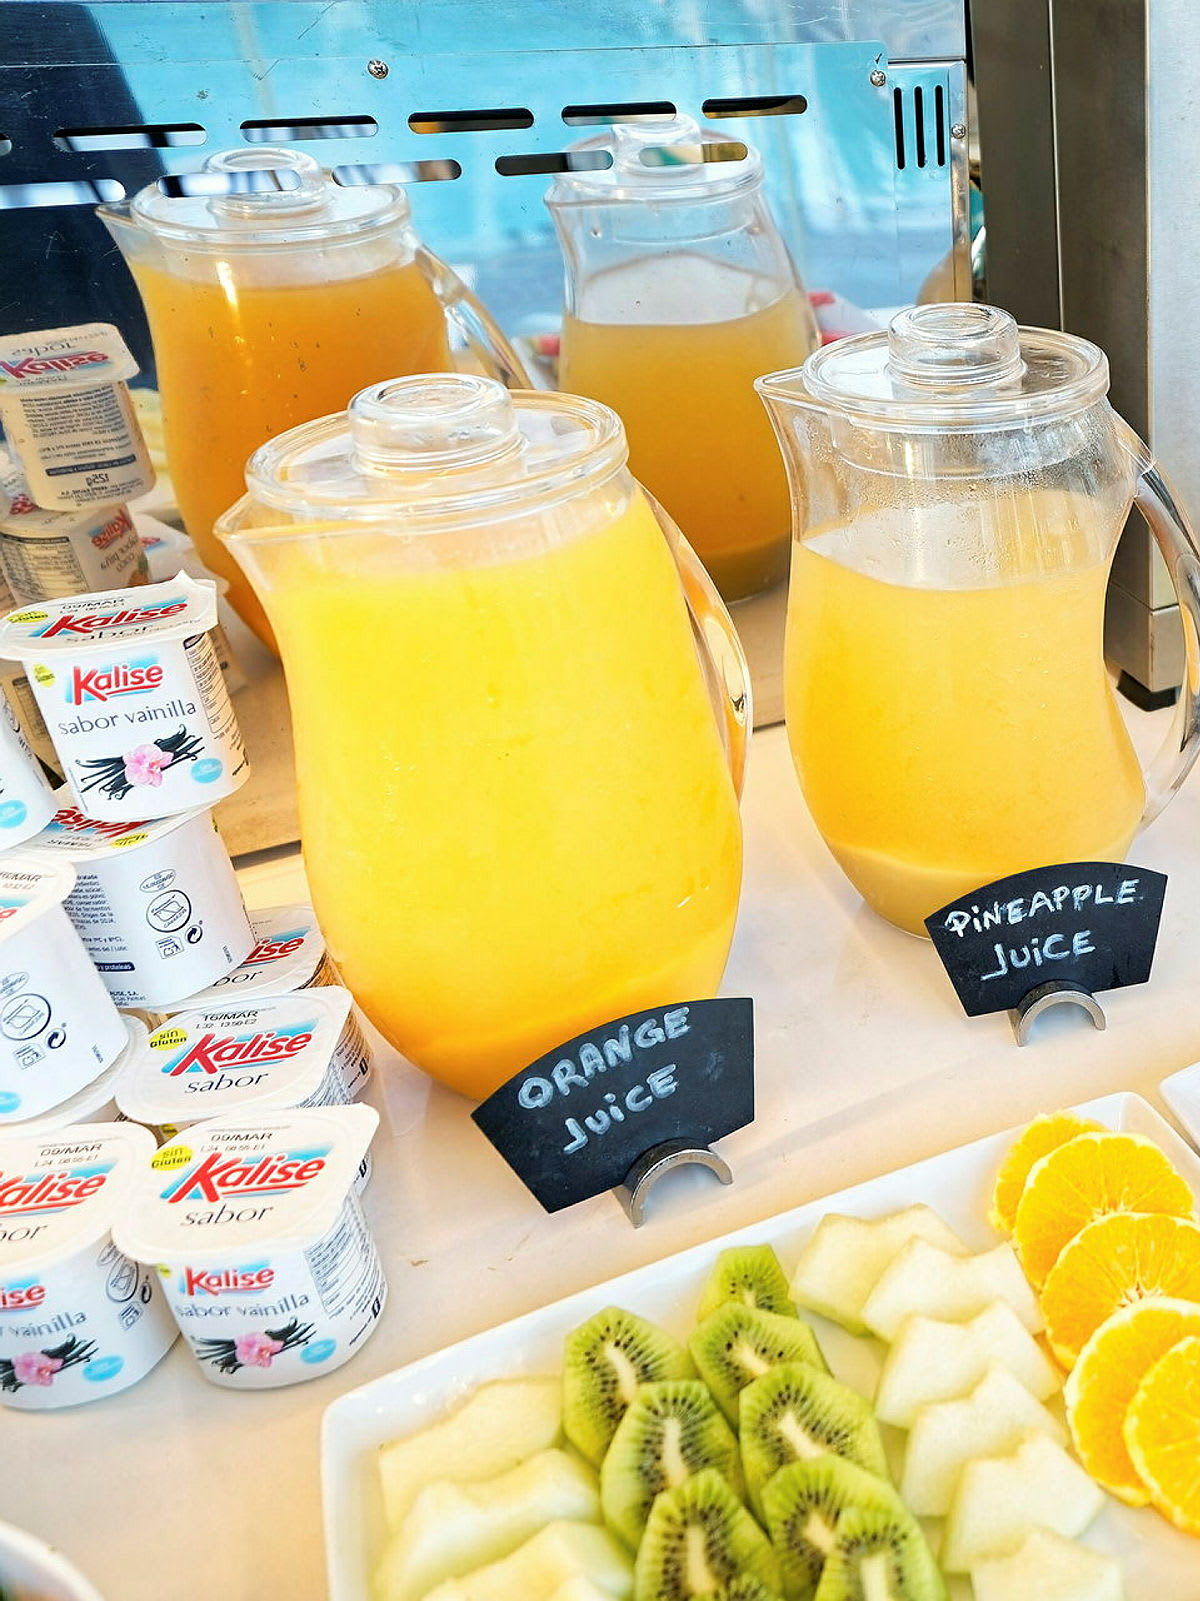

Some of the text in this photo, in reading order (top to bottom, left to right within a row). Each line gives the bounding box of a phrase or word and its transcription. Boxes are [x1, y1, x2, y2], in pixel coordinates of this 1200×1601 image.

[41, 603, 188, 638] Kalise
[73, 663, 163, 705] Kalise
[58, 699, 197, 736] sabor vainilla
[246, 937, 304, 964] ise
[150, 1036, 187, 1048] Gluten
[170, 1032, 312, 1077] Kalise
[517, 1006, 692, 1110] ORANGE
[184, 1072, 269, 1094] sabor
[40, 1143, 103, 1157] 09/MAR
[151, 1155, 192, 1169] Gluten
[168, 1152, 326, 1204] Kalise
[180, 1203, 274, 1226] sabor
[185, 1265, 275, 1297] Kalise
[0, 1284, 46, 1311] ise
[175, 1292, 309, 1317] sabor vainilla
[7, 1311, 88, 1339] vainilla
